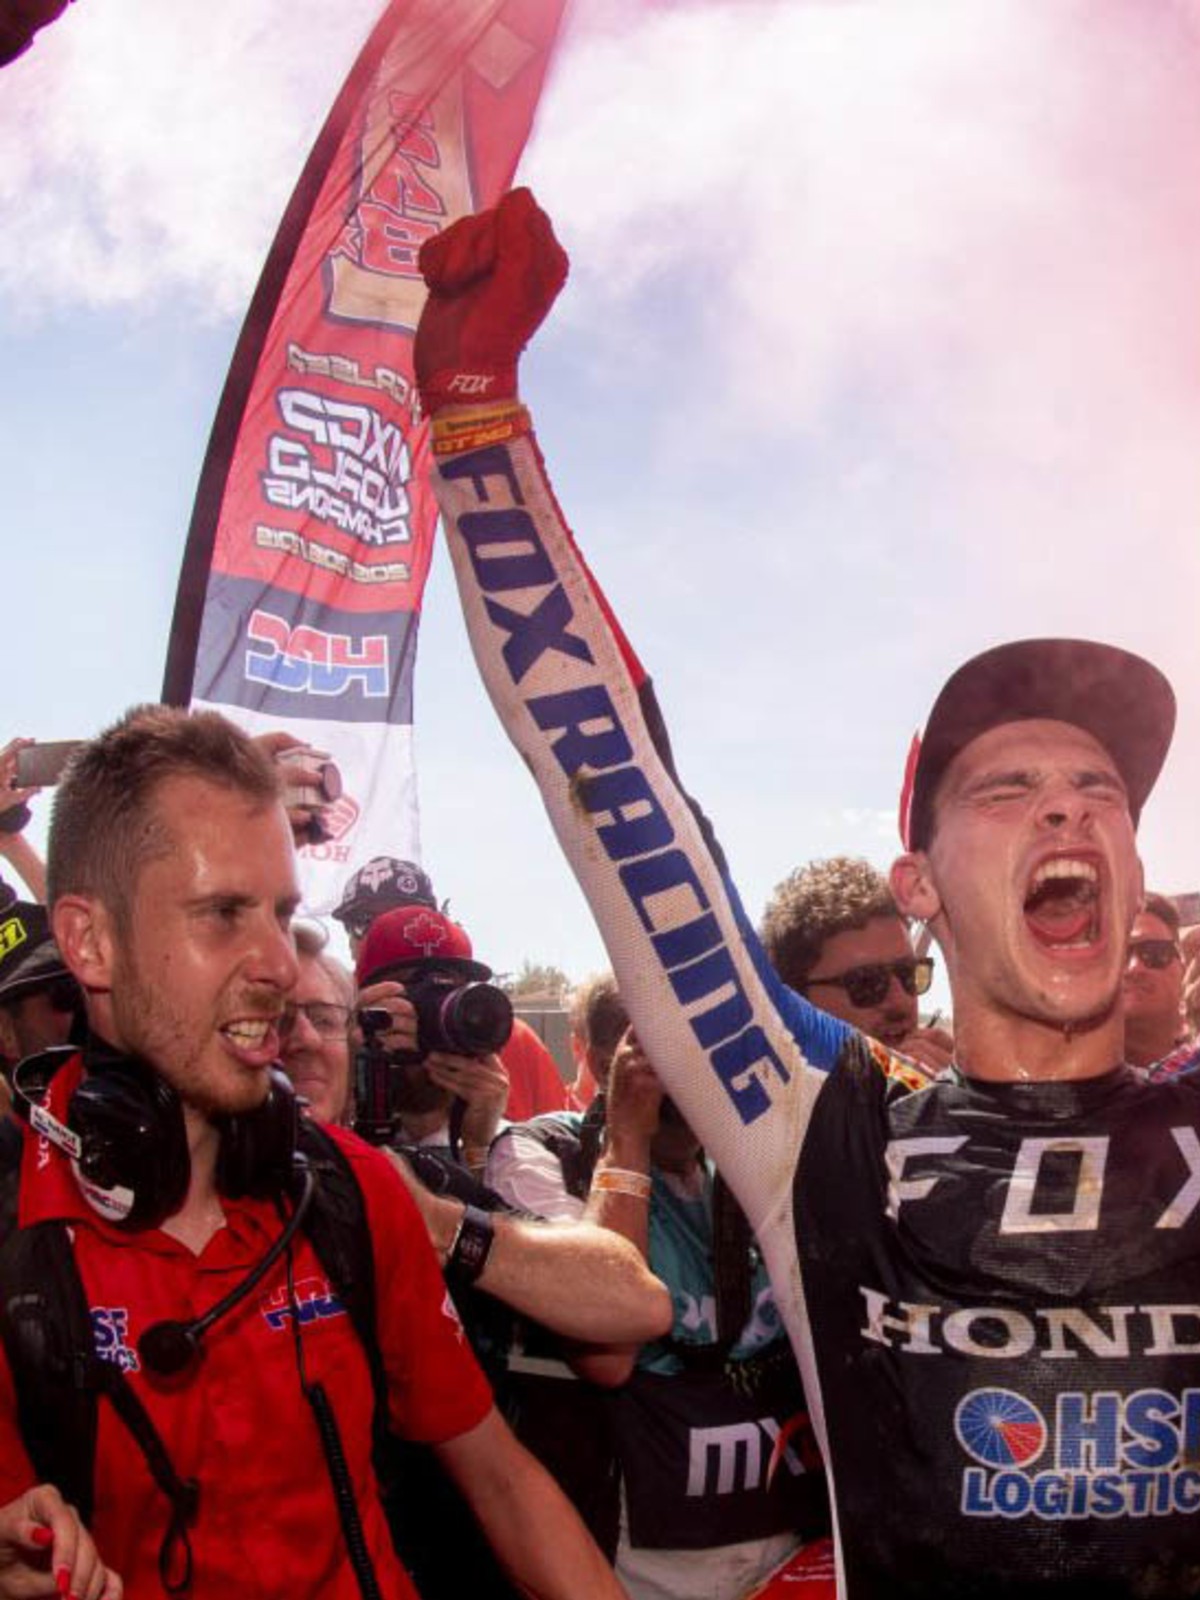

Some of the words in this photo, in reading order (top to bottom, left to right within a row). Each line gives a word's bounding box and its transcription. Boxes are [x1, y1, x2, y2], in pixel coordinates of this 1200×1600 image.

[447, 373, 496, 393] FOX
[438, 445, 597, 687] FOX
[524, 684, 791, 1126] RACING
